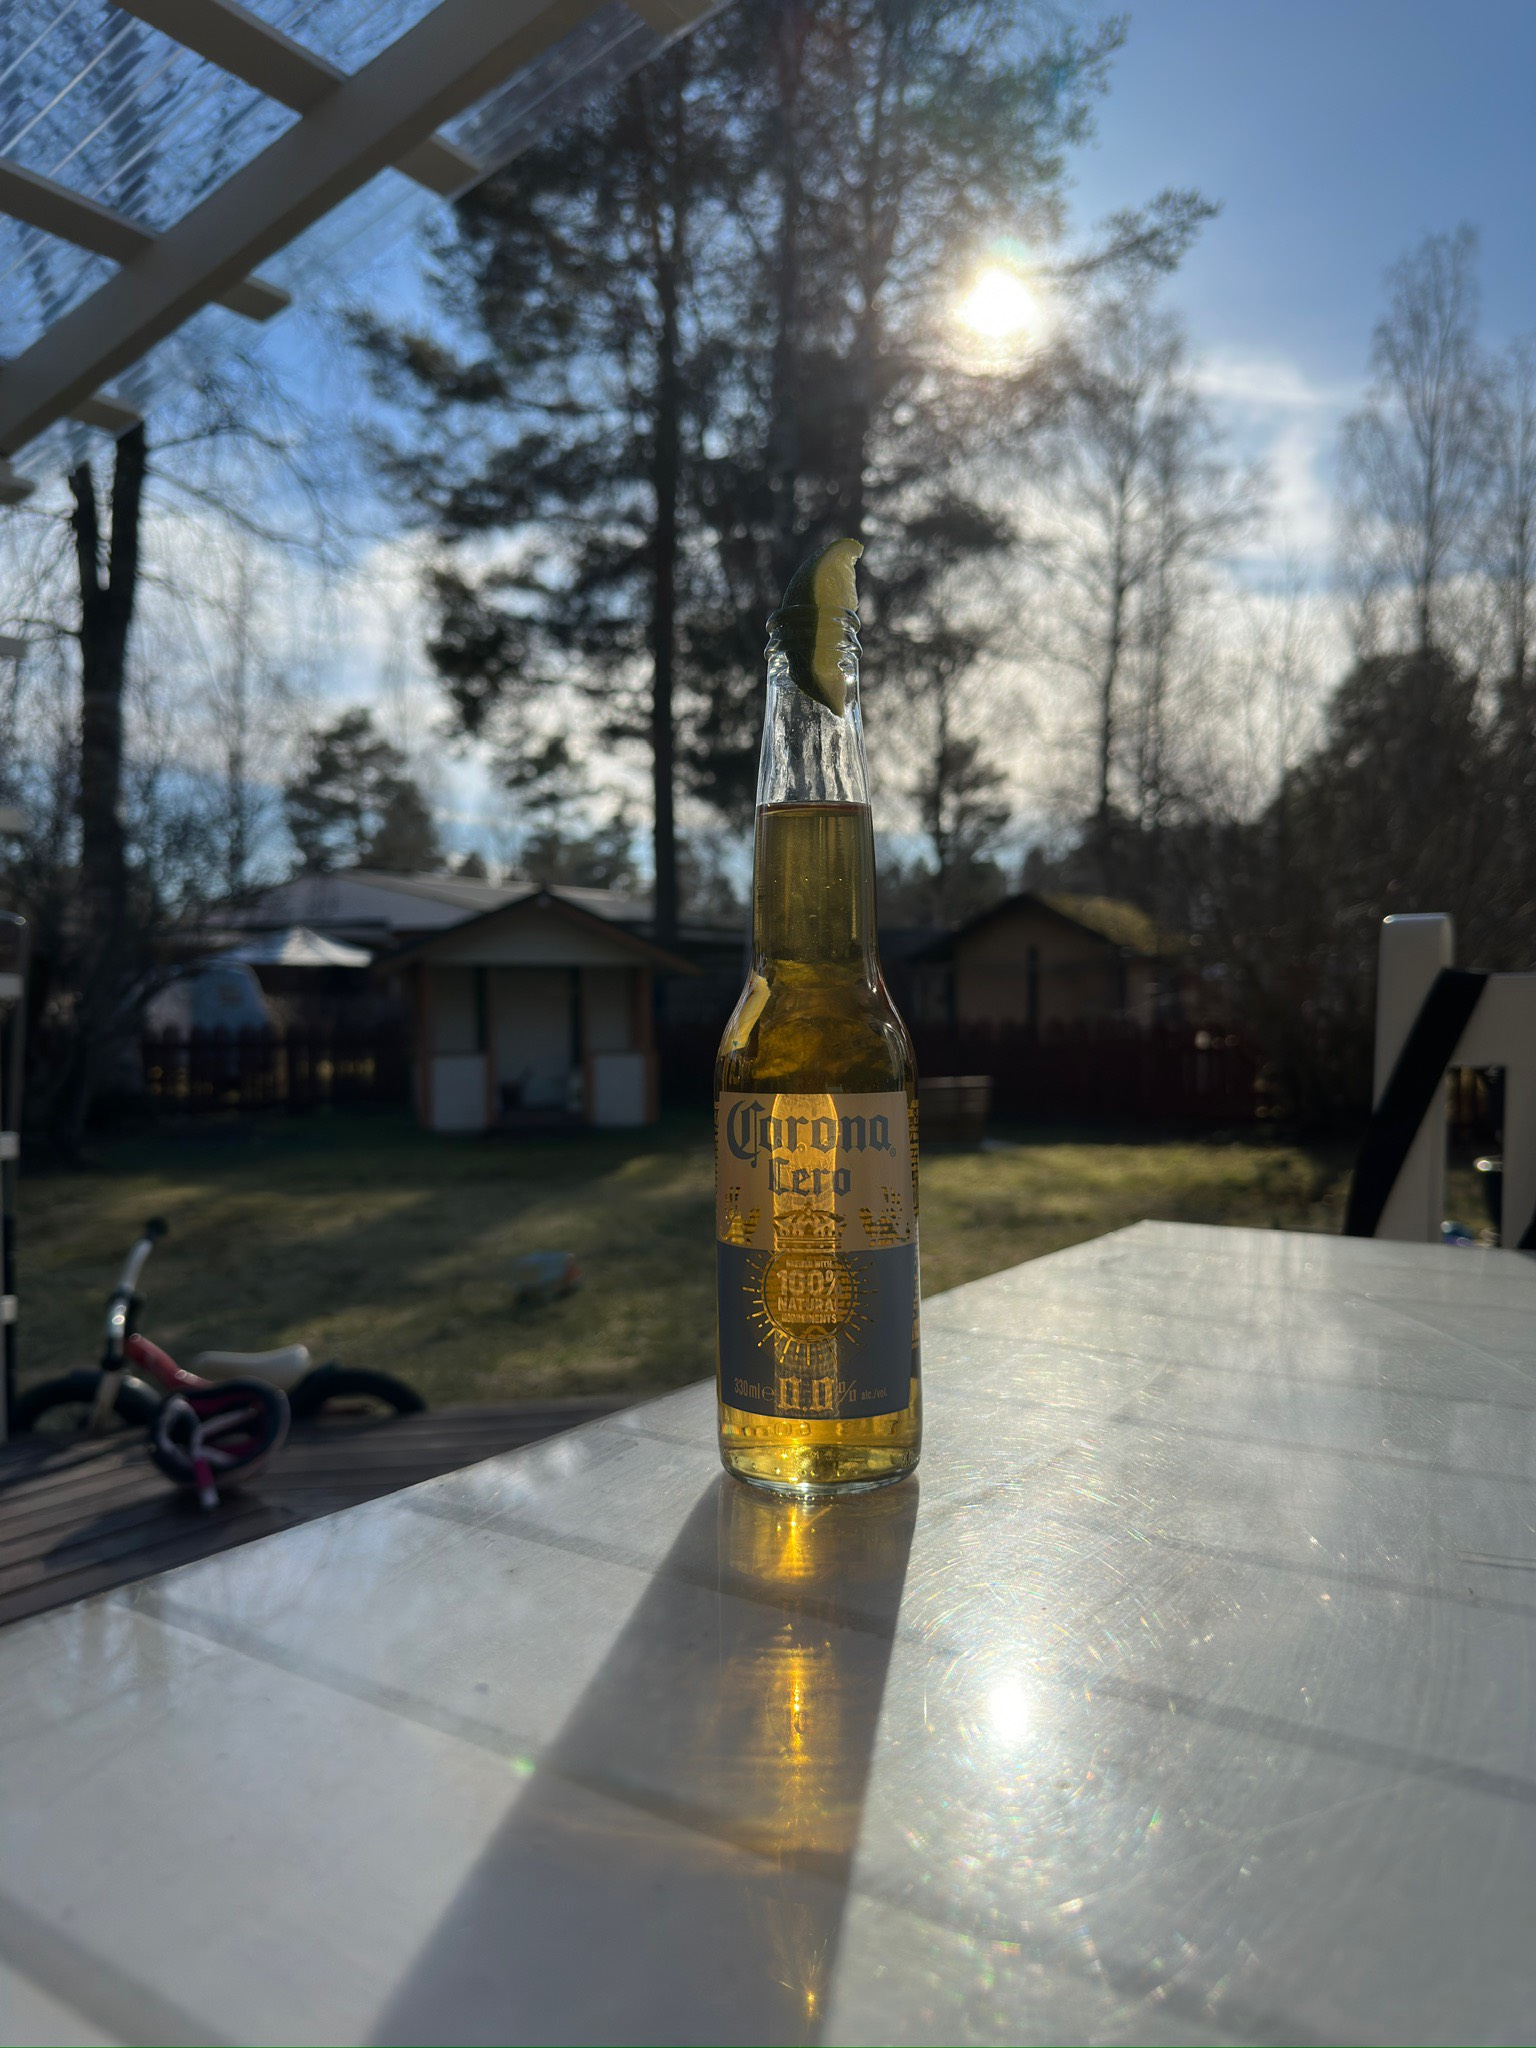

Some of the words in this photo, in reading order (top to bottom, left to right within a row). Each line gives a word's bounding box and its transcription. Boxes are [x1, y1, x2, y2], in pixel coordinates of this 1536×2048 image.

[768, 1157, 852, 1197] Cero
[785, 1259, 813, 1268] BREWED
[814, 1259, 835, 1268] WITH
[776, 1269, 843, 1297] 100%
[777, 1297, 841, 1312] NATURAL
[781, 1313, 838, 1324] INGREDIENTS
[734, 1376, 761, 1400] 330ml
